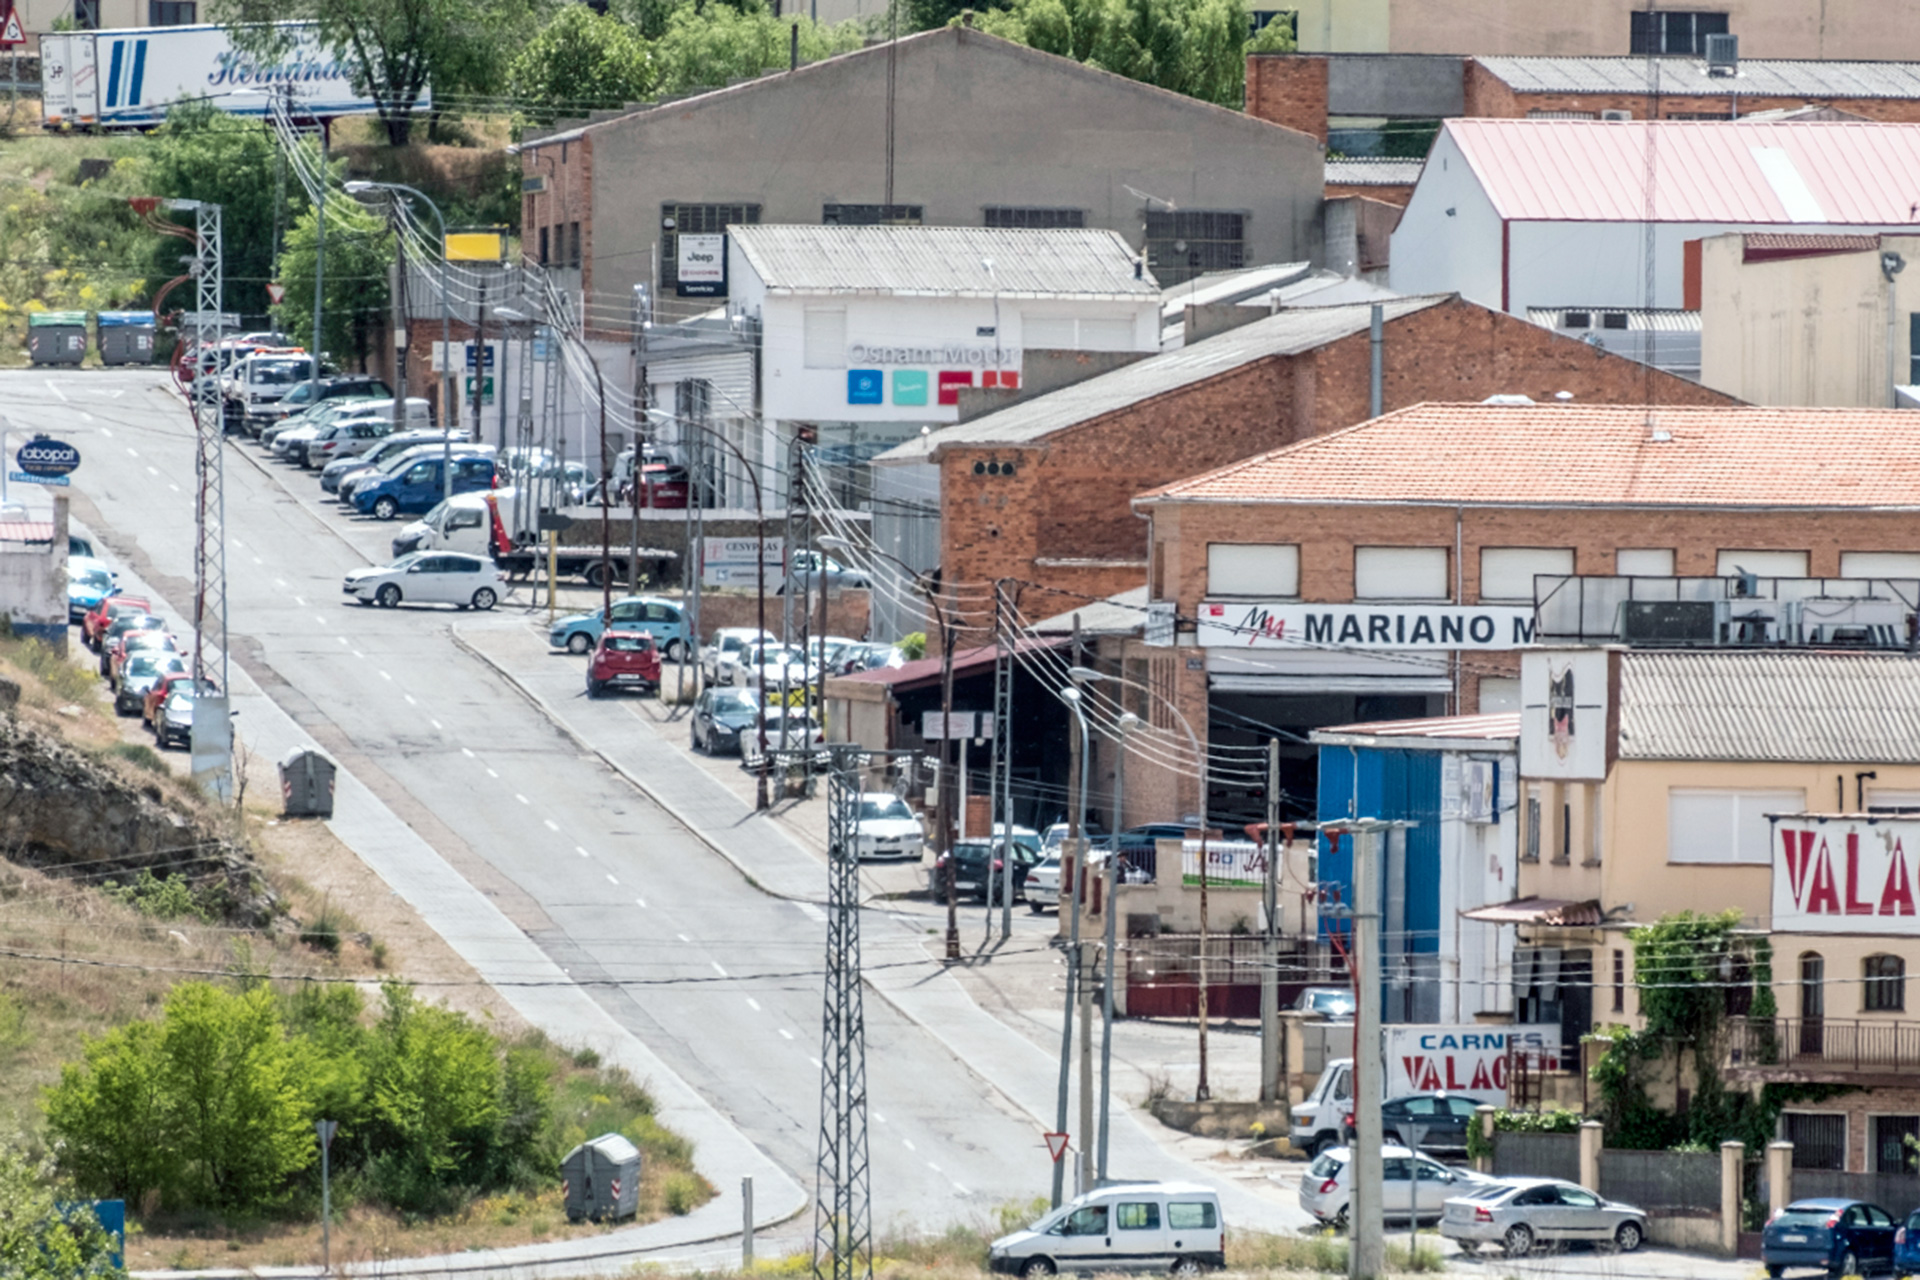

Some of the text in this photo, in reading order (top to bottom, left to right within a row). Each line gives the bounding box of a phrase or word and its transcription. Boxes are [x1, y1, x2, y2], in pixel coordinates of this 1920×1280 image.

[687, 251, 714, 263] Jeep
[943, 344, 1019, 365] Motor
[21, 446, 75, 463] labopat
[725, 542, 778, 551] CESYPAS
[1305, 614, 1495, 645] MARIANO
[1781, 828, 1920, 916] VALA
